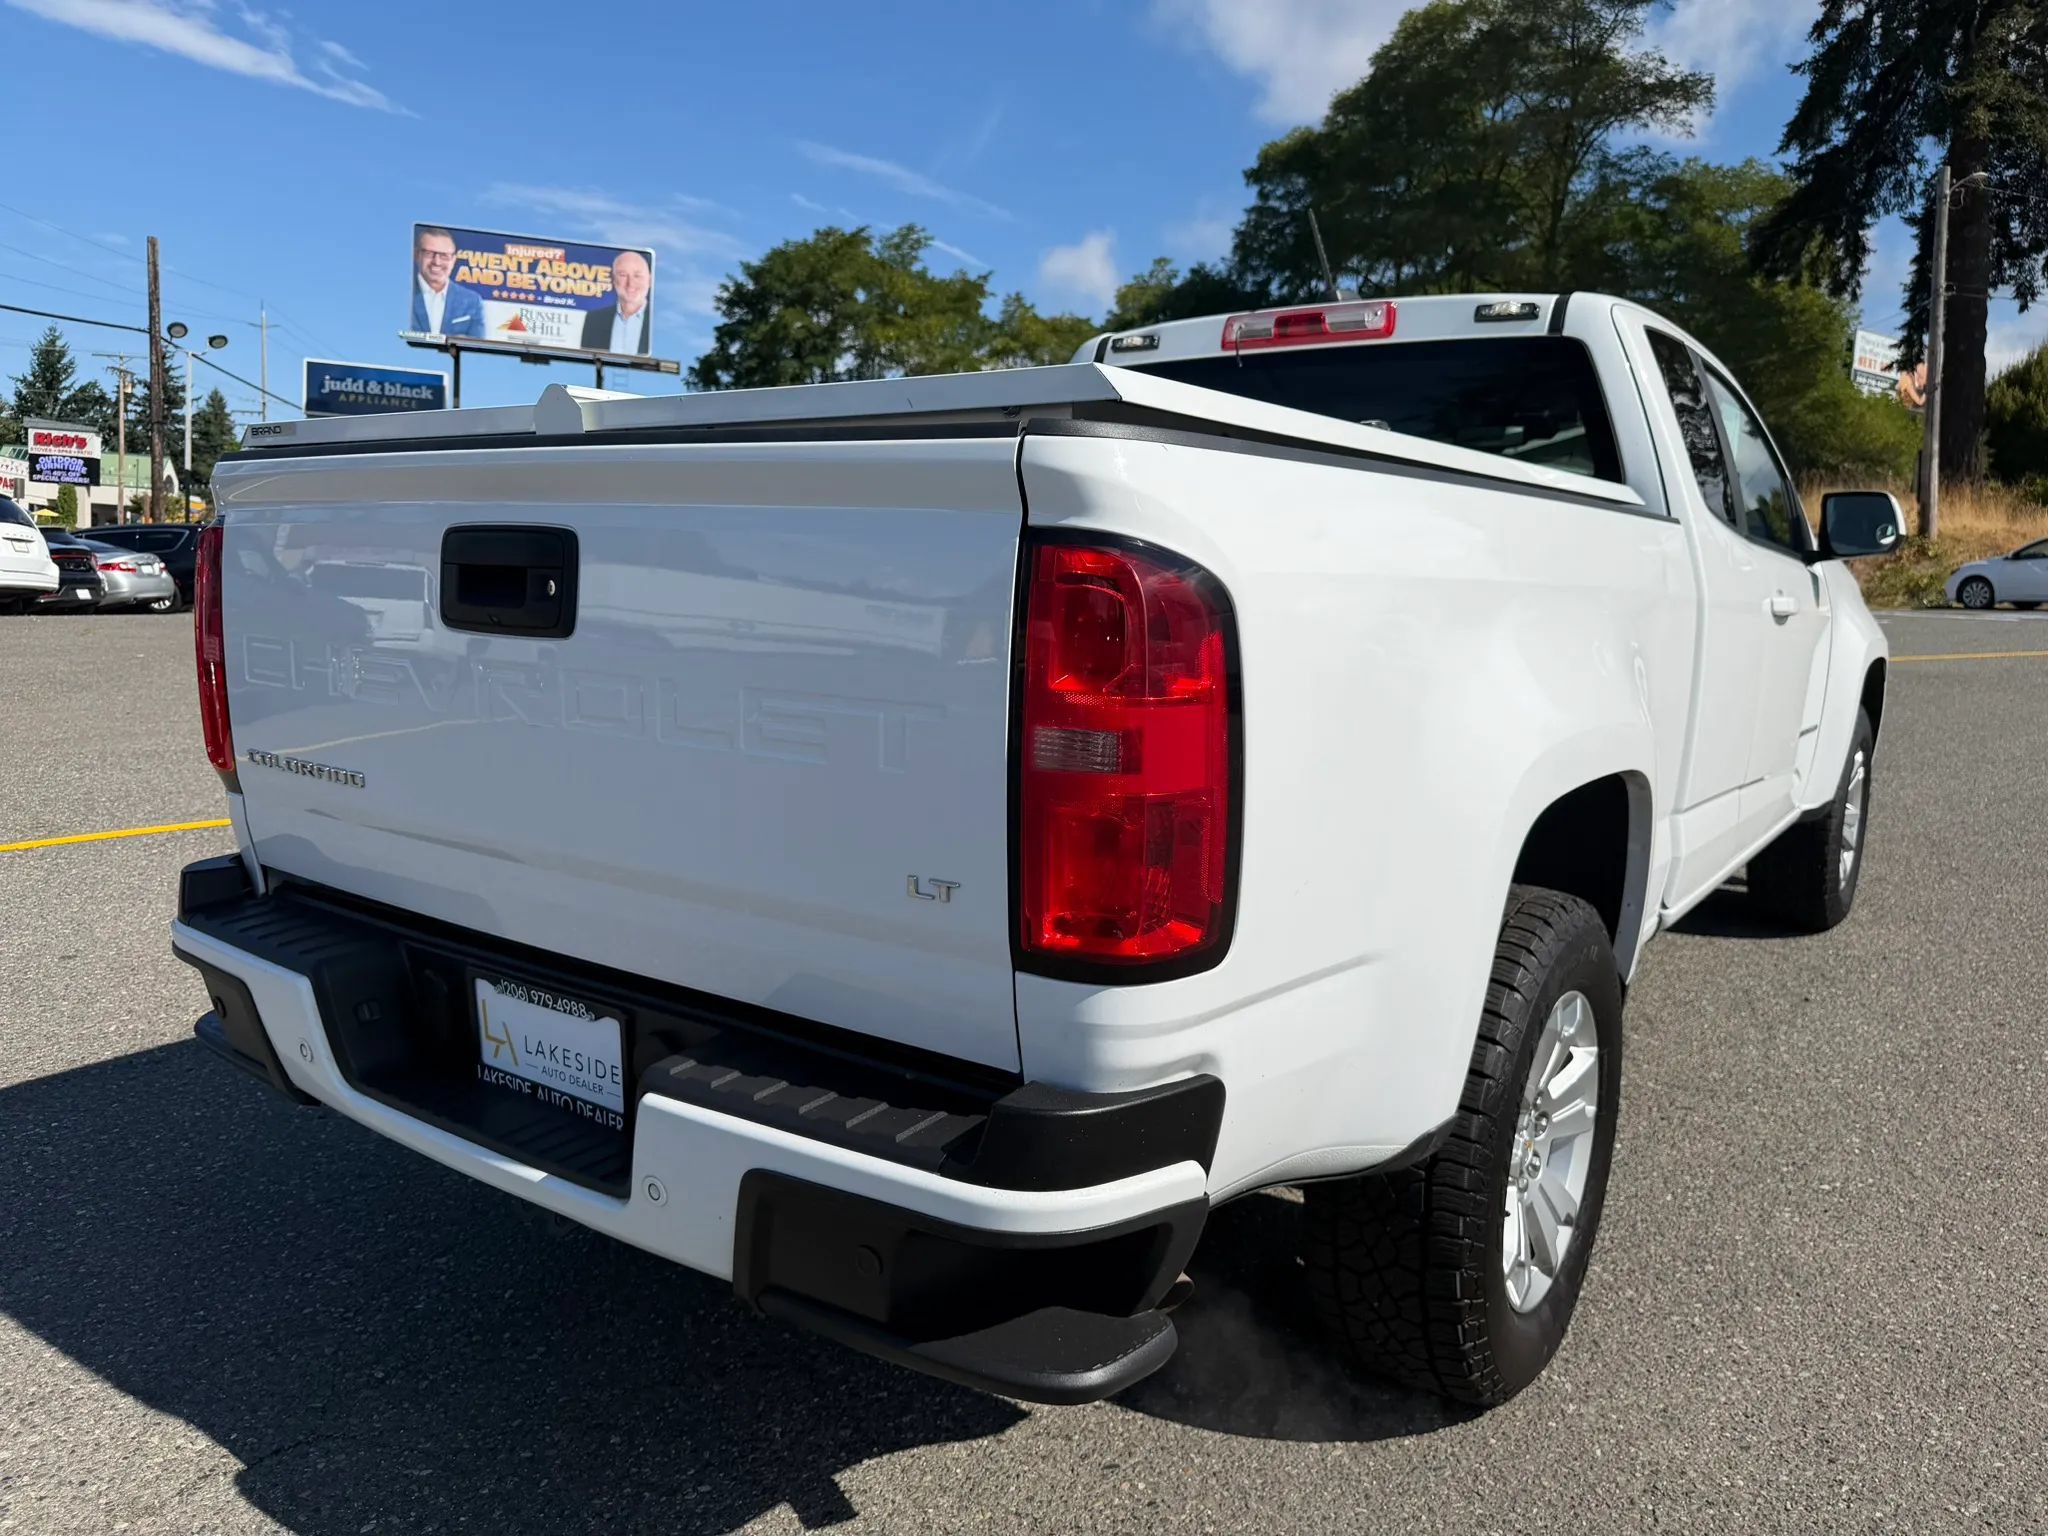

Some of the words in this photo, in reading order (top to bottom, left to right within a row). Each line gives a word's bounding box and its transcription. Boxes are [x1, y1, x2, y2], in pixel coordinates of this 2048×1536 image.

[507, 245, 562, 260] Injured?
[455, 265, 504, 287] AND
[535, 259, 612, 284] ABOVE
[320, 375, 364, 394] judd
[366, 380, 382, 395] &
[384, 382, 434, 400] black
[338, 393, 417, 409] APPLIANCE
[33, 432, 88, 450] Rich's
[251, 426, 282, 436] BRAND
[35, 462, 88, 475] FURNITURE
[38, 456, 84, 466] OUTDOOR
[32, 474, 59, 482] SPECIAL
[243, 633, 948, 774] CHEVROLET
[247, 748, 366, 788] COLORADO
[907, 875, 961, 903] LT
[500, 979, 529, 1002] (206)
[530, 990, 587, 1018] 979-4988
[524, 1034, 622, 1085] LAKESIDE
[541, 1065, 566, 1082] AUTO
[569, 1074, 604, 1096] DEALER
